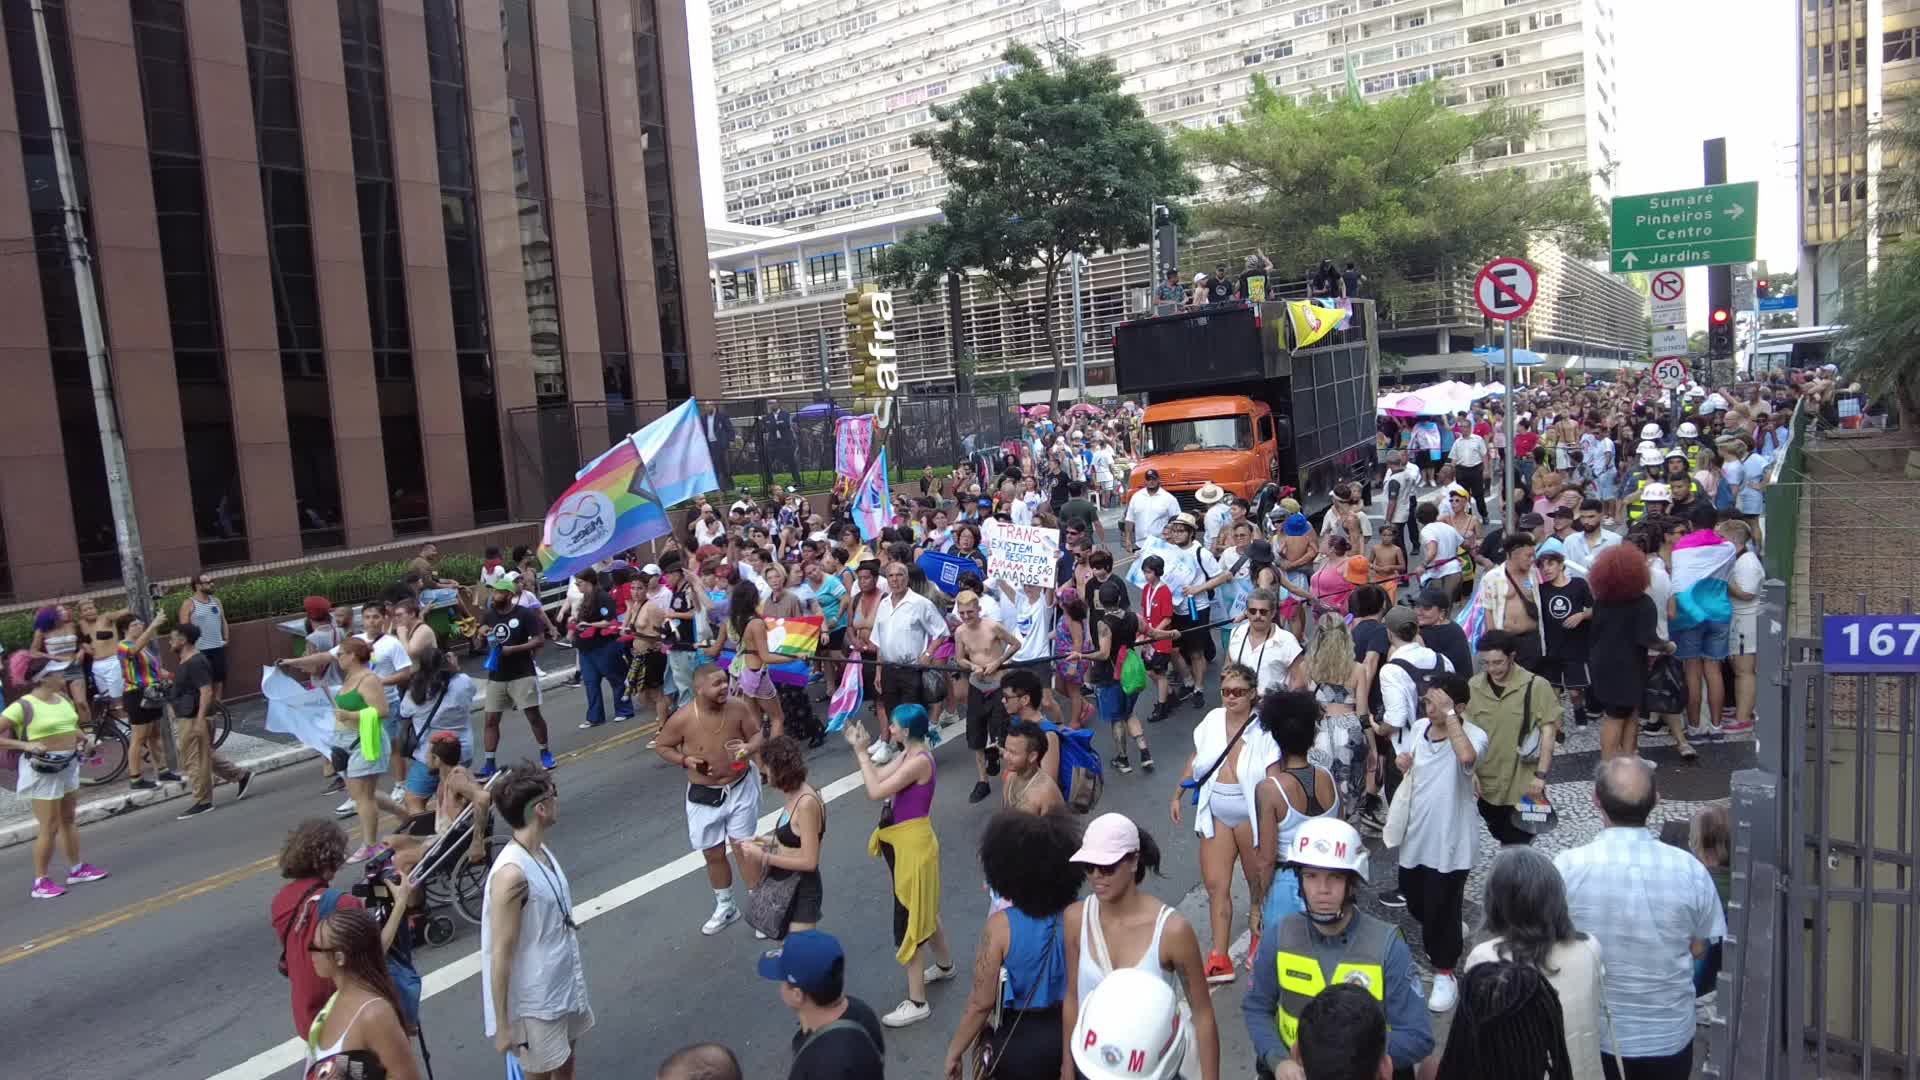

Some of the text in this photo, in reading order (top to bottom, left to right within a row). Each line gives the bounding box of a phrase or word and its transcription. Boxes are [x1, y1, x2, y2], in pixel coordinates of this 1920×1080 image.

[1650, 190, 1713, 209] Sumaré
[1636, 210, 1713, 226] Pinheiros
[1656, 226, 1712, 240] Centro
[1648, 250, 1711, 264] Jardins
[1659, 366, 1680, 379] 50
[997, 524, 1041, 544] TRANS
[992, 538, 1033, 553] EXISTEM
[991, 558, 1024, 571] AMAM
[1028, 565, 1033, 573] E
[993, 569, 1040, 584] AMADOS
[1300, 837, 1347, 859] P M
[1084, 1029, 1147, 1073] P M
